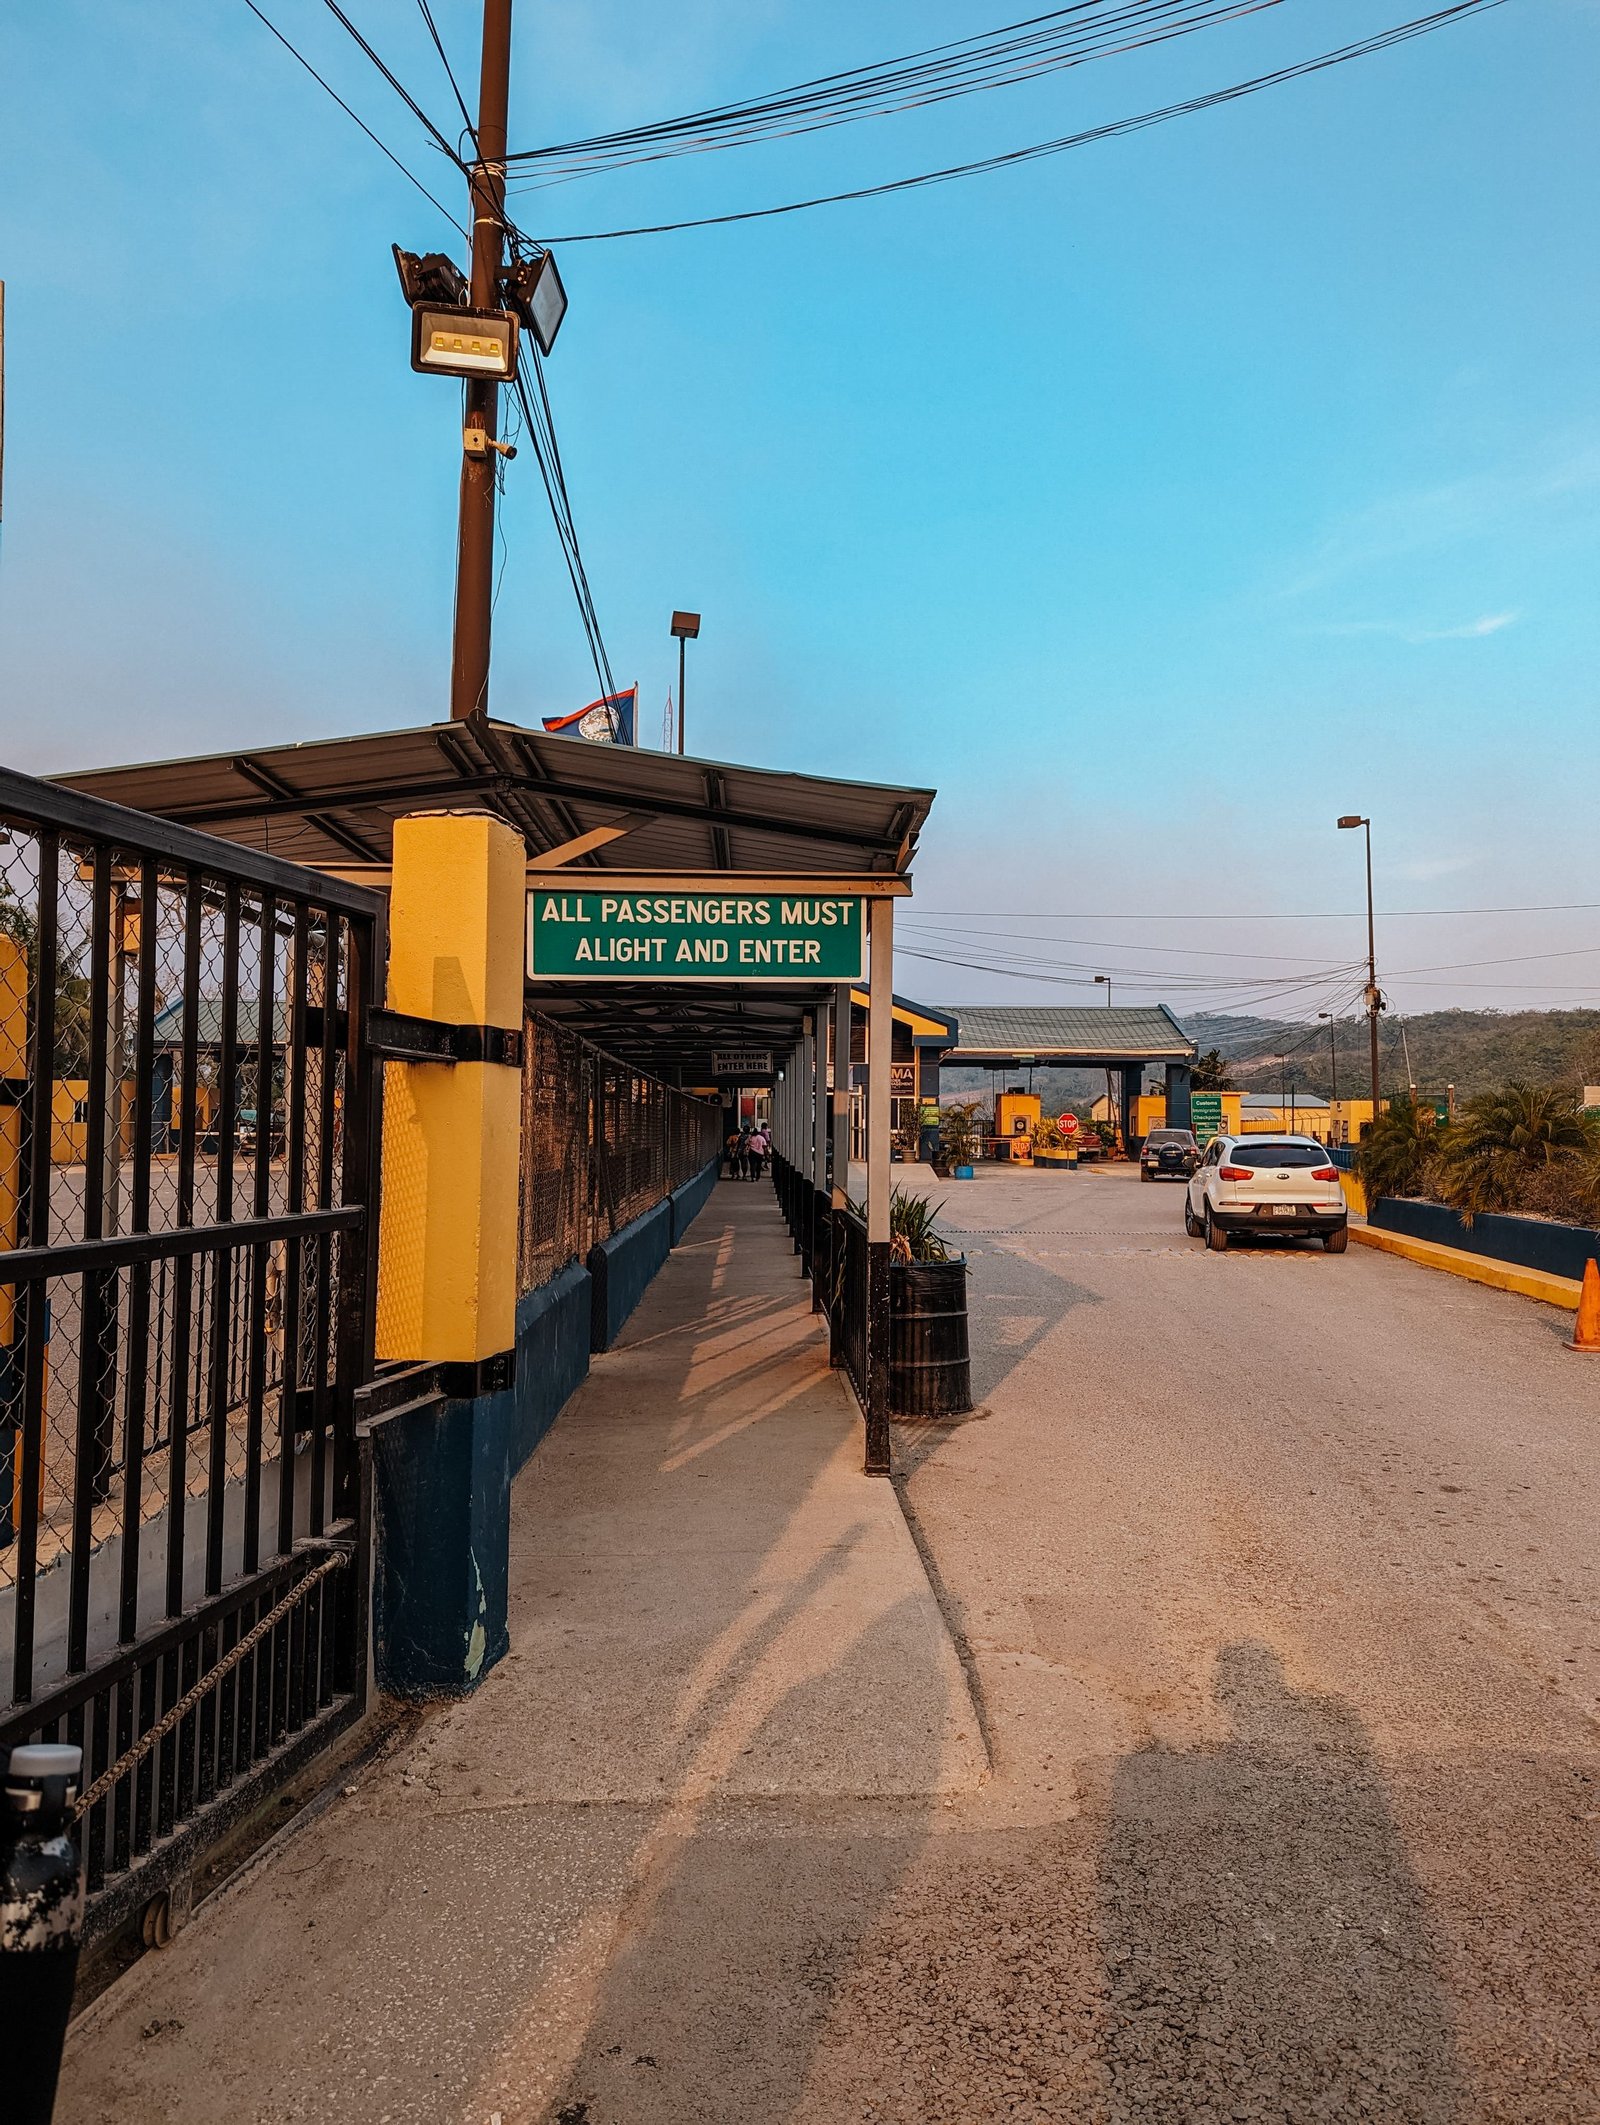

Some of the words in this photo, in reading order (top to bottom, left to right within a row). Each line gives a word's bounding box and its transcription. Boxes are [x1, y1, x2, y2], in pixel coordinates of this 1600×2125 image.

[542, 898, 592, 923] ALL
[601, 899, 771, 925] PASSENGERS
[781, 901, 854, 925] MUST
[575, 938, 667, 963] ALIGHT
[675, 939, 729, 963] AND
[740, 940, 821, 964] ENTER
[717, 1062, 745, 1071] ENTER
[746, 1062, 768, 1070] HERE
[891, 1068, 913, 1079] MA
[1060, 1120, 1077, 1128] STOP
